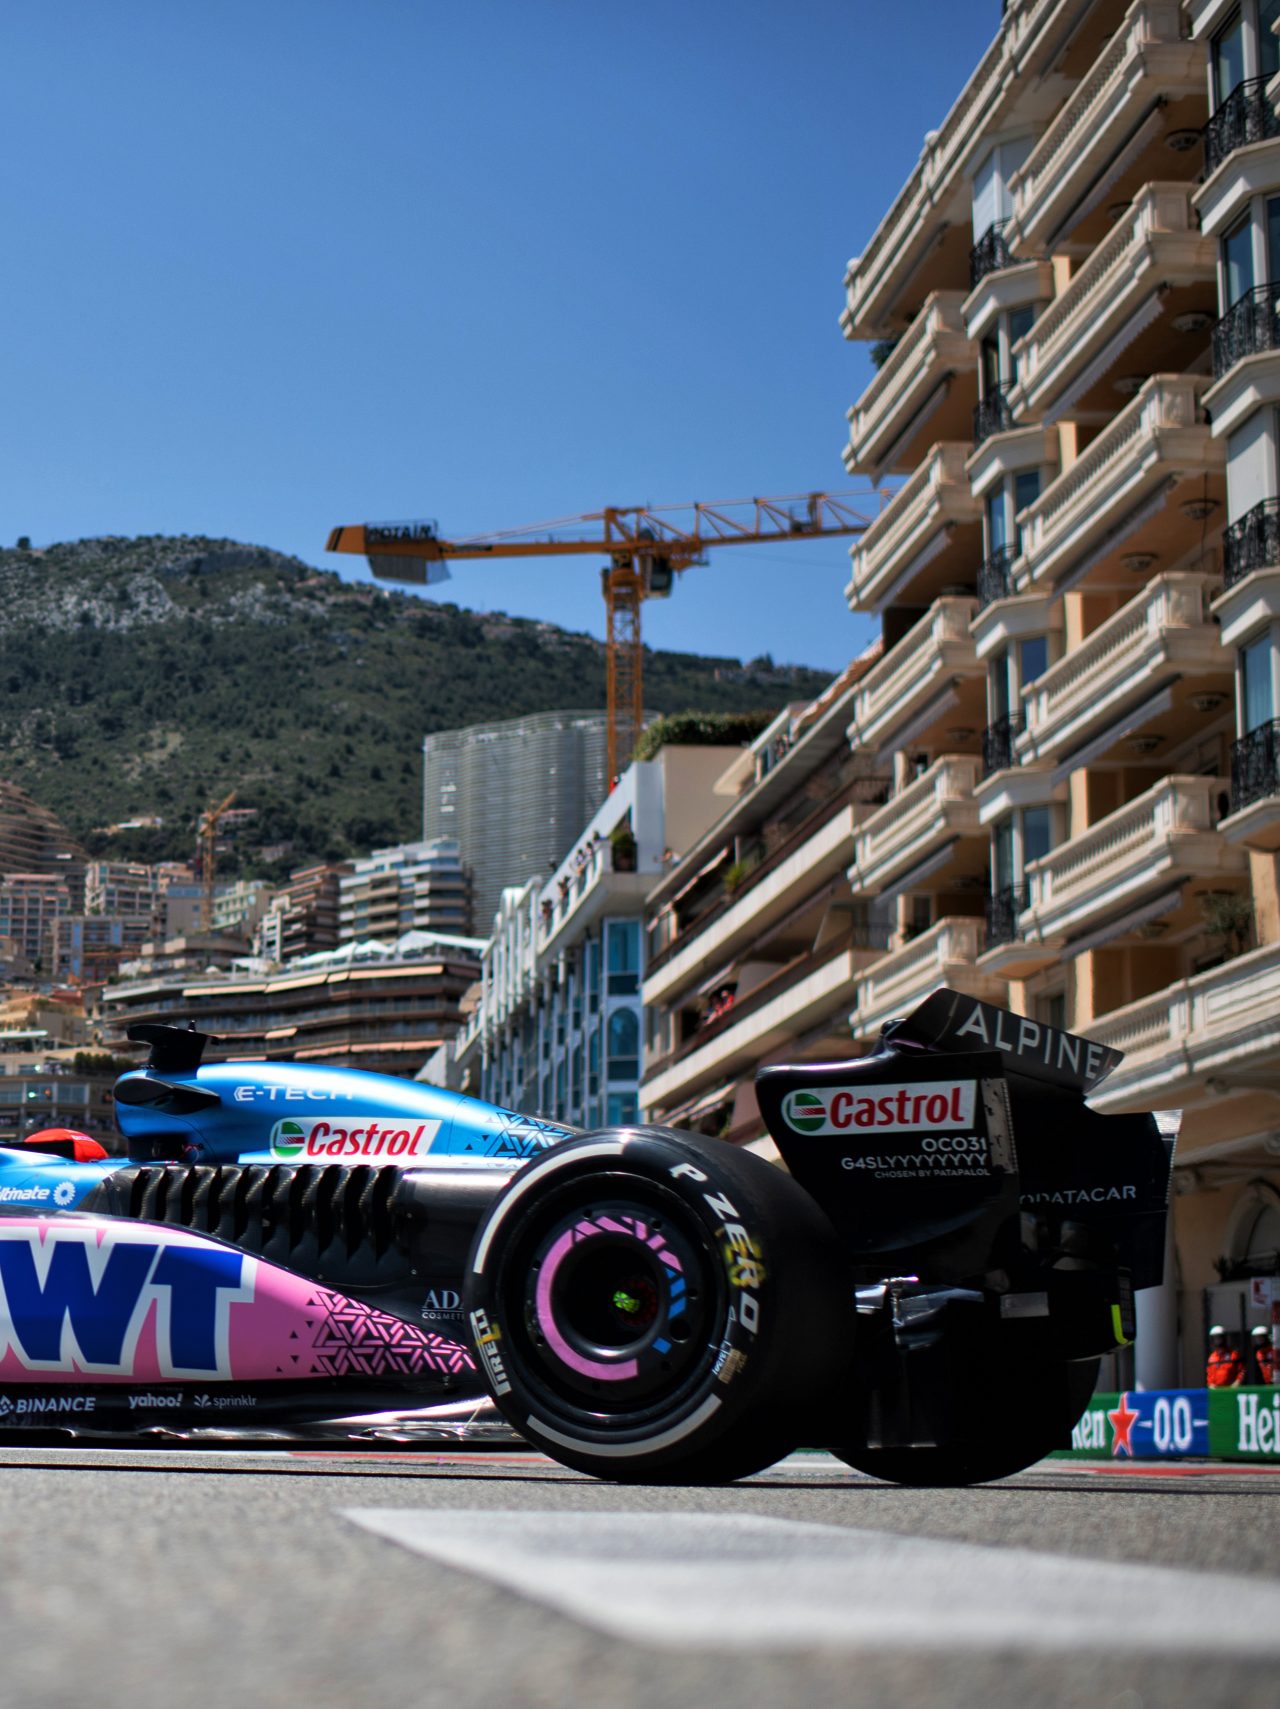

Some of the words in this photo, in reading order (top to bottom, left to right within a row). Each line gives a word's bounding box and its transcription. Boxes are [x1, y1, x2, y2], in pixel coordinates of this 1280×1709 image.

[956, 1003, 1103, 1080] ALPINE
[233, 1085, 353, 1101] E-TECH
[829, 1087, 965, 1129] Castrol
[306, 1122, 426, 1157] Castrol
[921, 1137, 987, 1152] OCO31
[841, 1153, 988, 1170] G4SLYYYYYYYY
[874, 1170, 916, 1179] CHOSEN
[919, 1169, 932, 1177] BY
[934, 1168, 991, 1177] PATAPALOL
[669, 1162, 708, 1182] P
[702, 1192, 760, 1334] ZERO
[422, 1289, 464, 1309] AD
[16, 1397, 96, 1413] BINANCE
[128, 1393, 183, 1409] yahoo!
[213, 1395, 257, 1408] sprinklr
